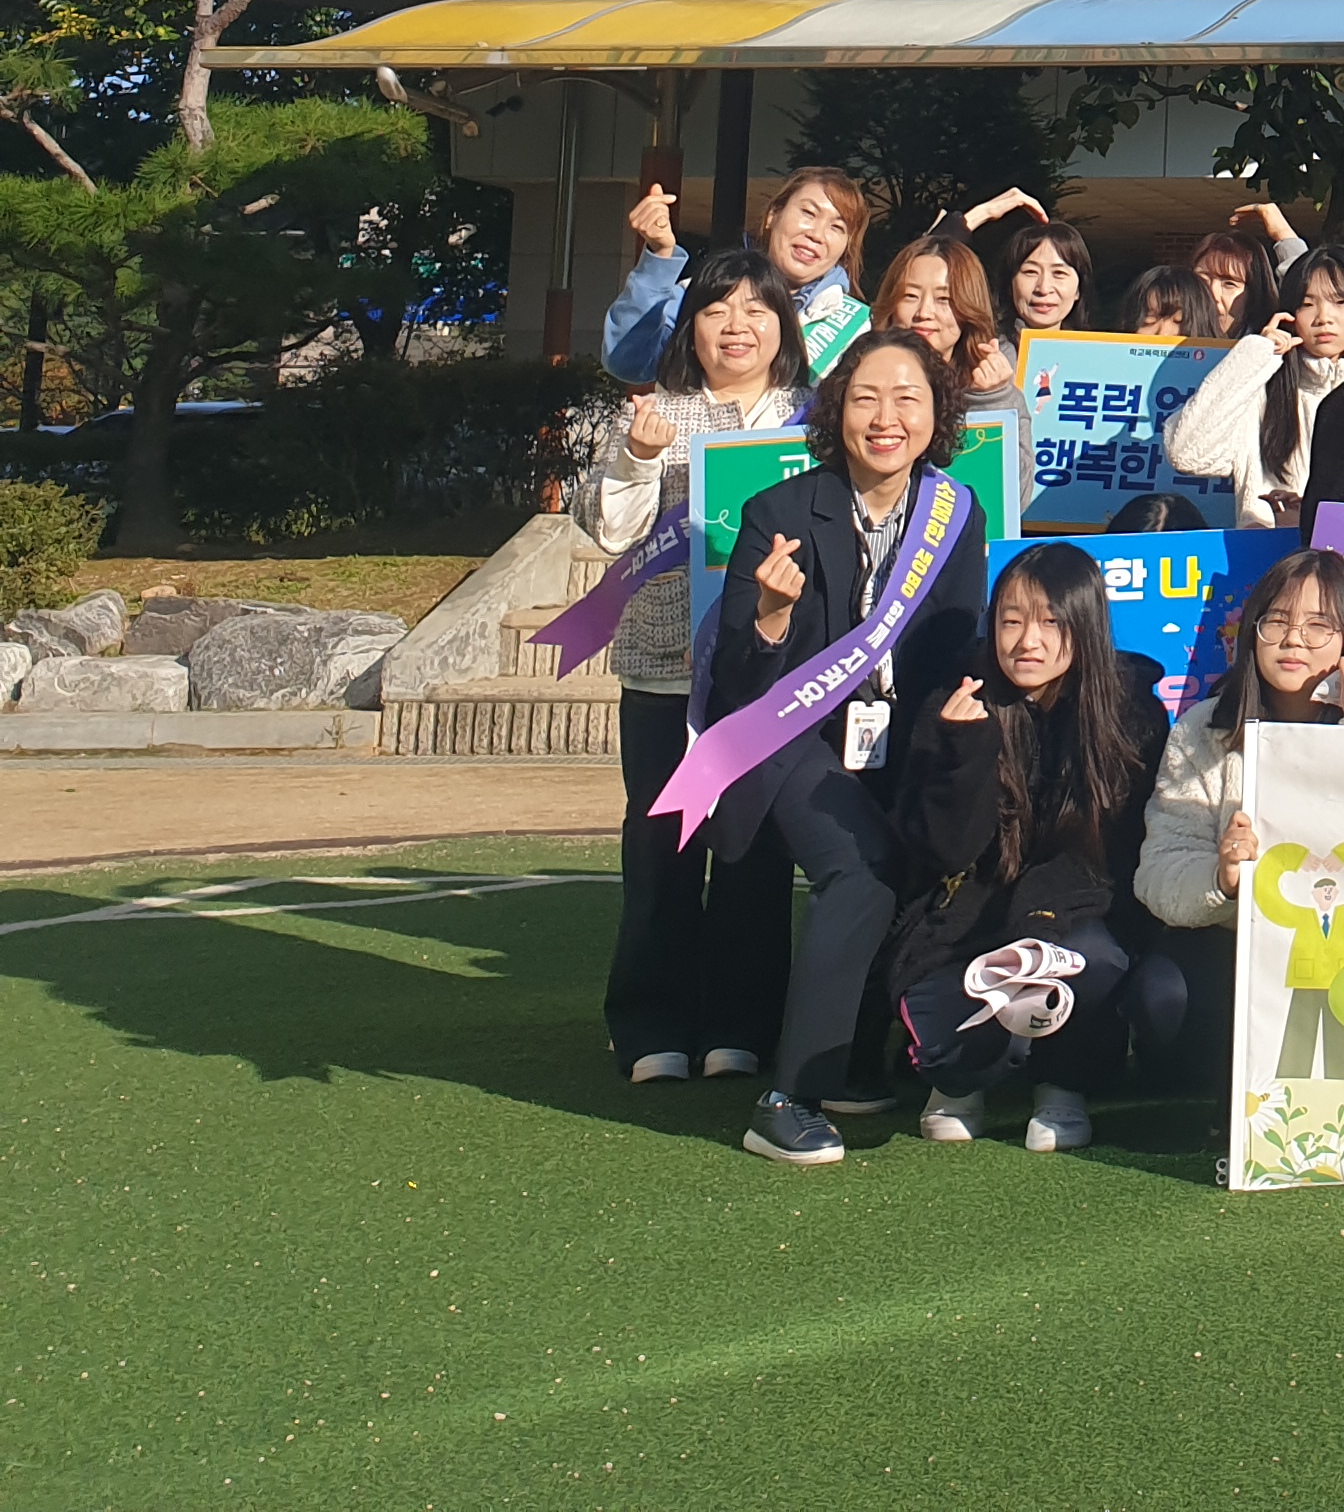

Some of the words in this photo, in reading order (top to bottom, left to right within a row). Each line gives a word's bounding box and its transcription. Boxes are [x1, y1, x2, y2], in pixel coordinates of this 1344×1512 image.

[1058, 380, 1142, 432] 폭력
[1034, 438, 1163, 491] 행복한
[1159, 556, 1213, 601] 나,
[777, 646, 869, 719] 지켜요!
